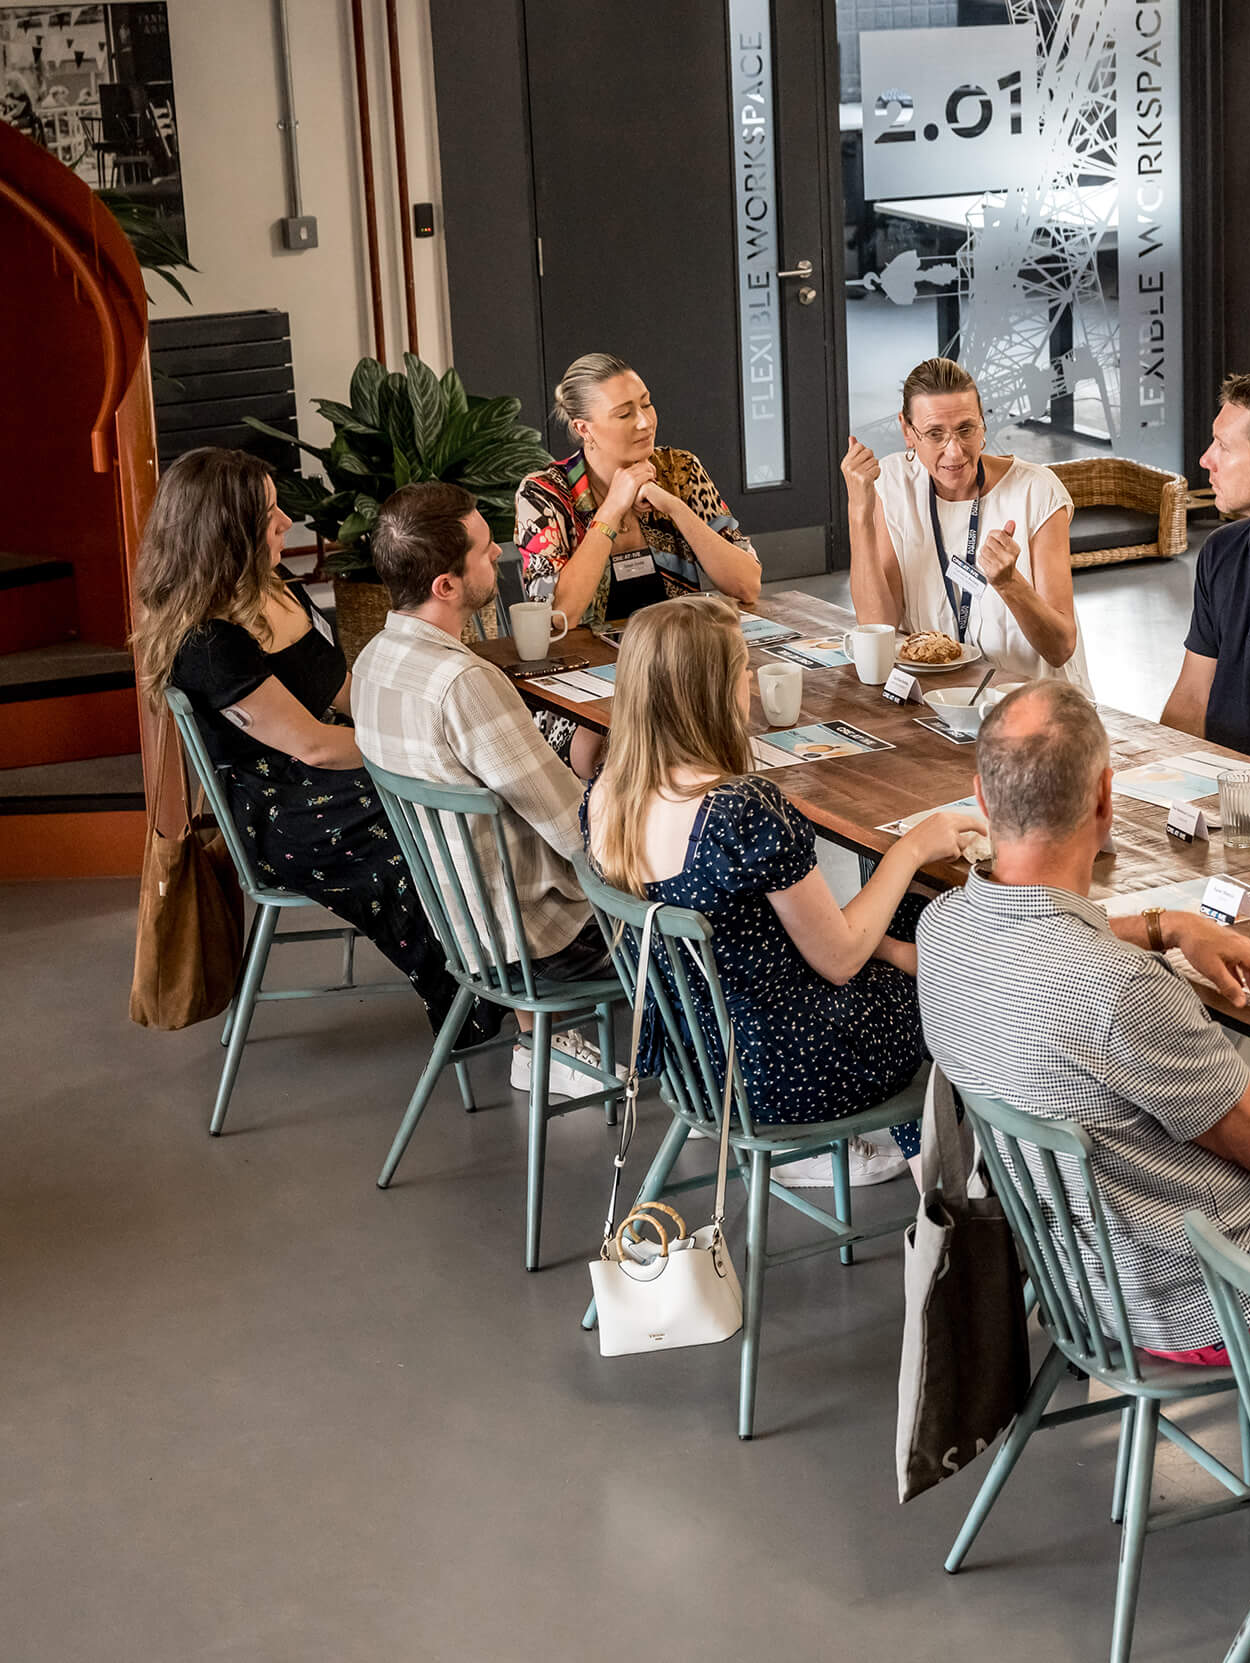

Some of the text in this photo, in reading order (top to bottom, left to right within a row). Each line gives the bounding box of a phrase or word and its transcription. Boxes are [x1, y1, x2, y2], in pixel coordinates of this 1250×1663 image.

[739, 31, 775, 420] FLEXIBLE WORKSPACE
[874, 70, 1022, 145] 2.01
[1135, 0, 1165, 259] WORKSPAC
